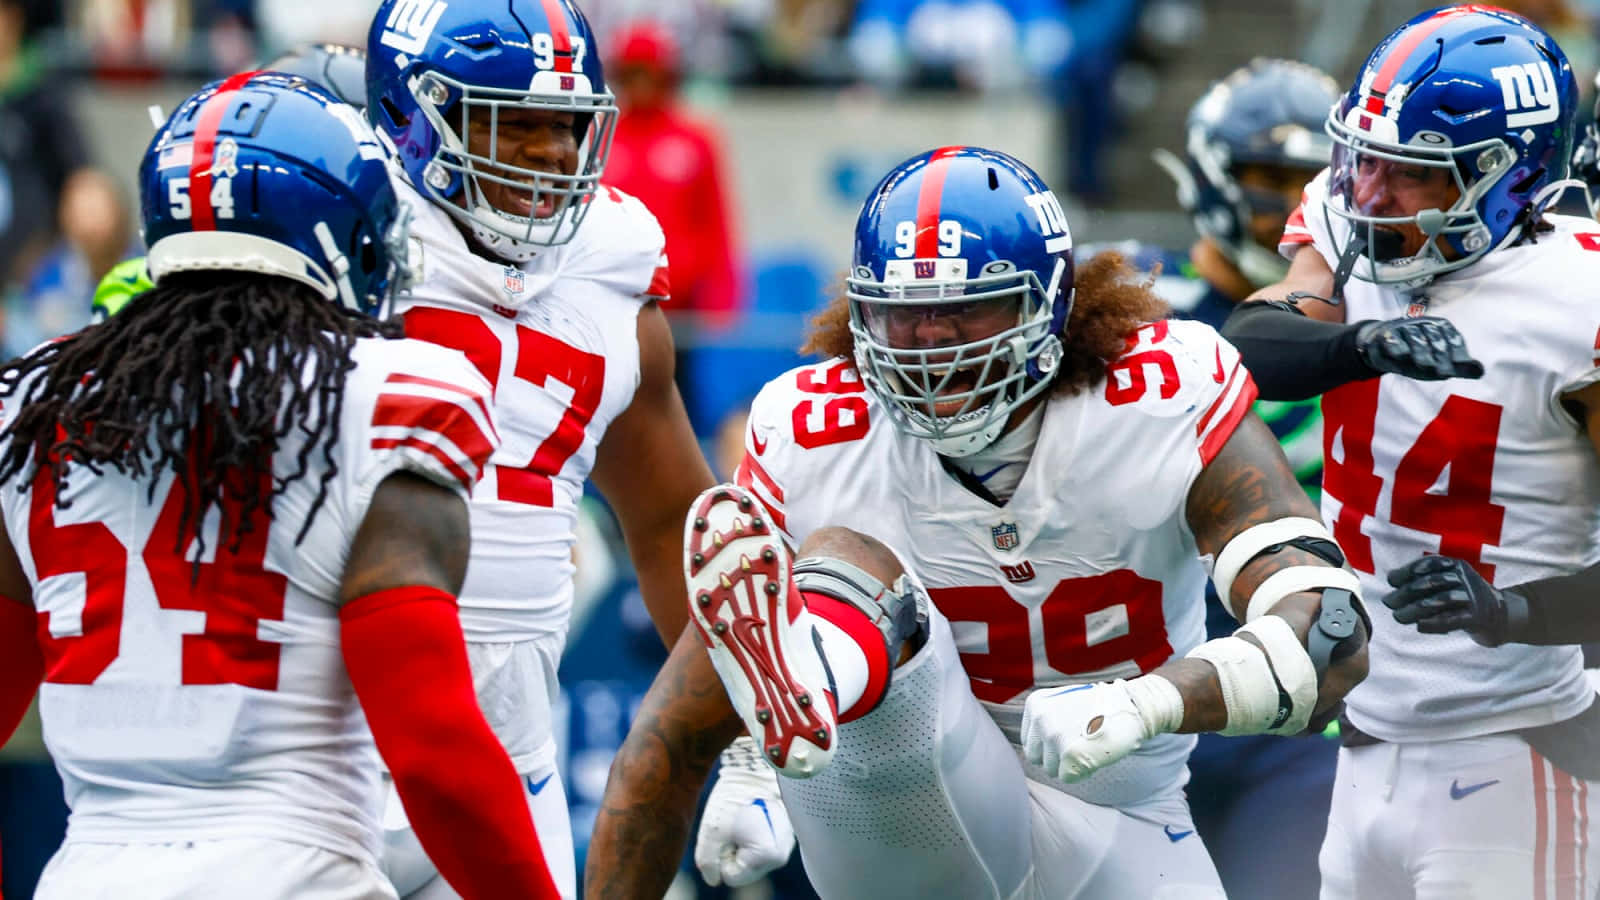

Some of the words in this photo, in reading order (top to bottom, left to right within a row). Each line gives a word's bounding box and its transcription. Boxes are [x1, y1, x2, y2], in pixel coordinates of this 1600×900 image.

[532, 32, 587, 73] 97
[1490, 60, 1560, 129] ny
[167, 177, 235, 220] 54
[895, 220, 962, 258] 99
[791, 360, 871, 450] 99
[1320, 376, 1506, 585] 44
[28, 402, 289, 692] 54
[996, 533, 1017, 549] NFL
[927, 567, 1175, 705] 99
